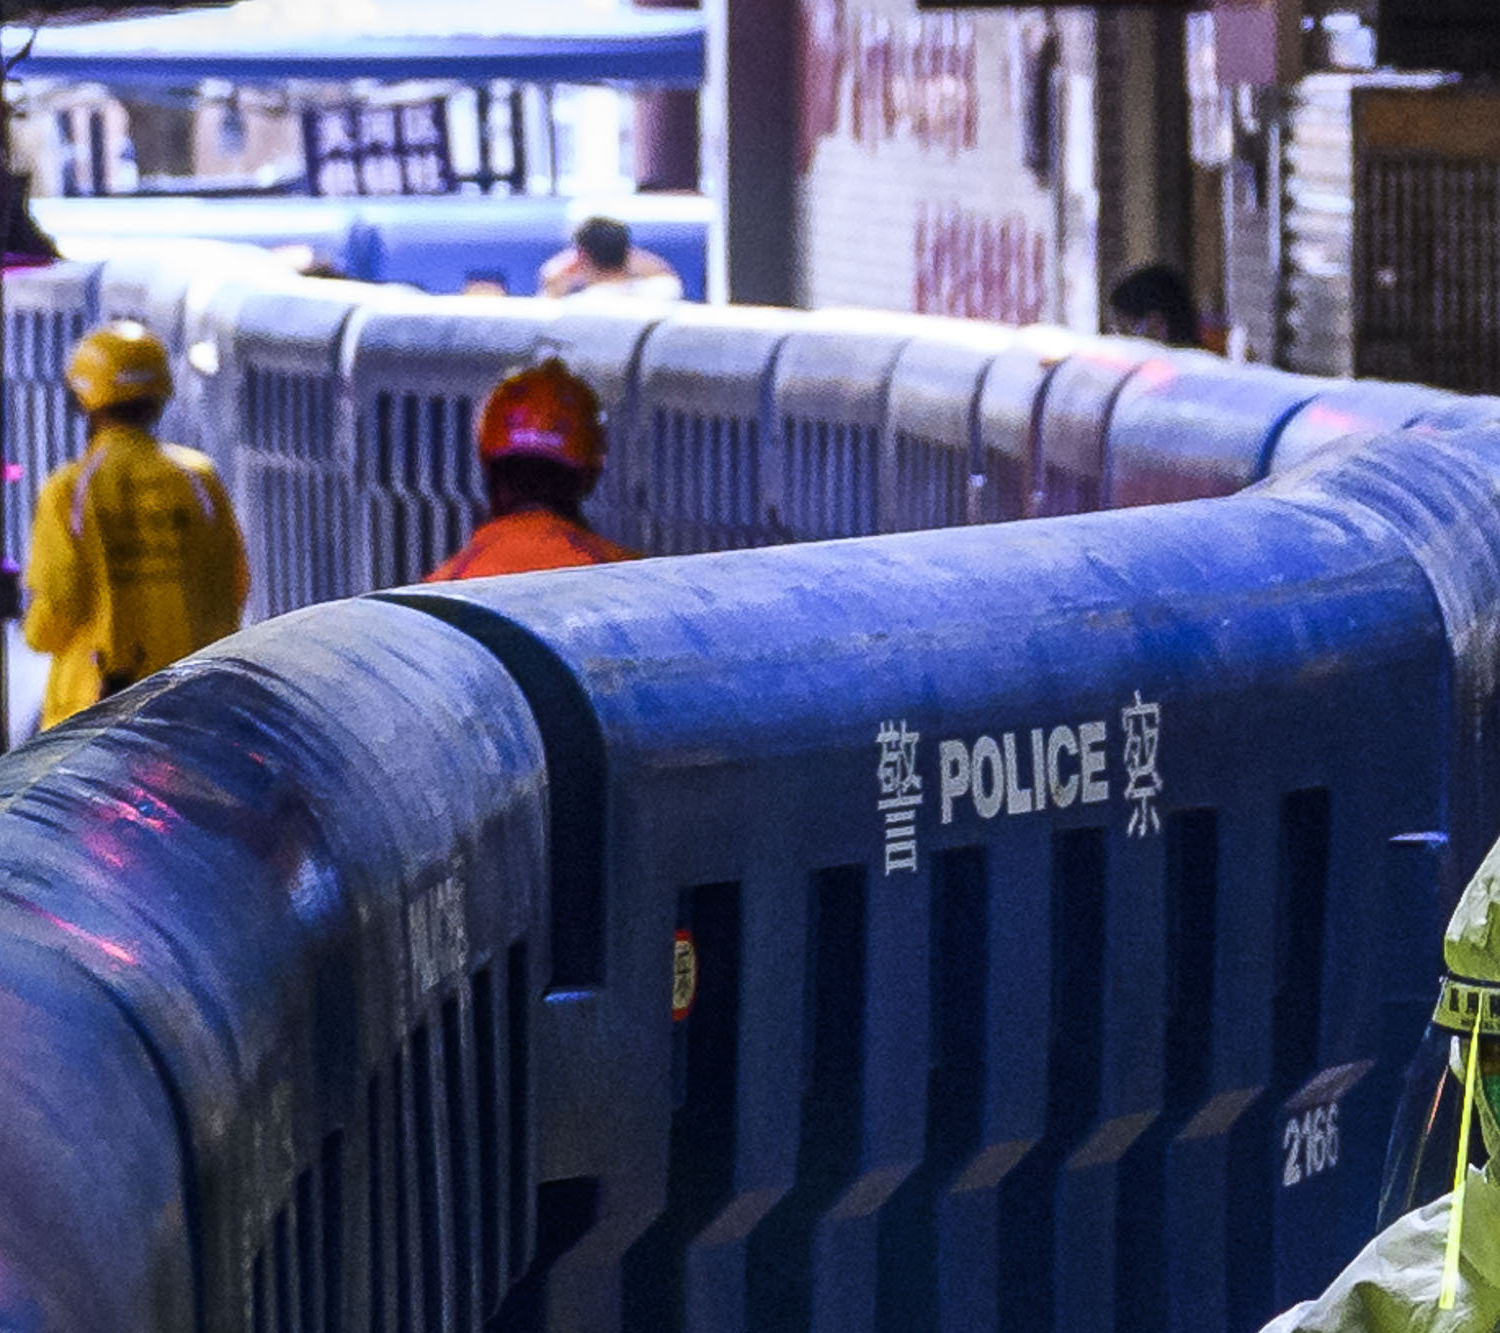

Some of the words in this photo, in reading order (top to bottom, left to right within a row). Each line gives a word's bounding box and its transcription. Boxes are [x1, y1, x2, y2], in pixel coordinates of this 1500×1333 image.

[876, 719, 923, 876] 警
[938, 720, 1110, 824] POLICE
[1122, 688, 1163, 838] 察
[1283, 1102, 1339, 1187] 2166
